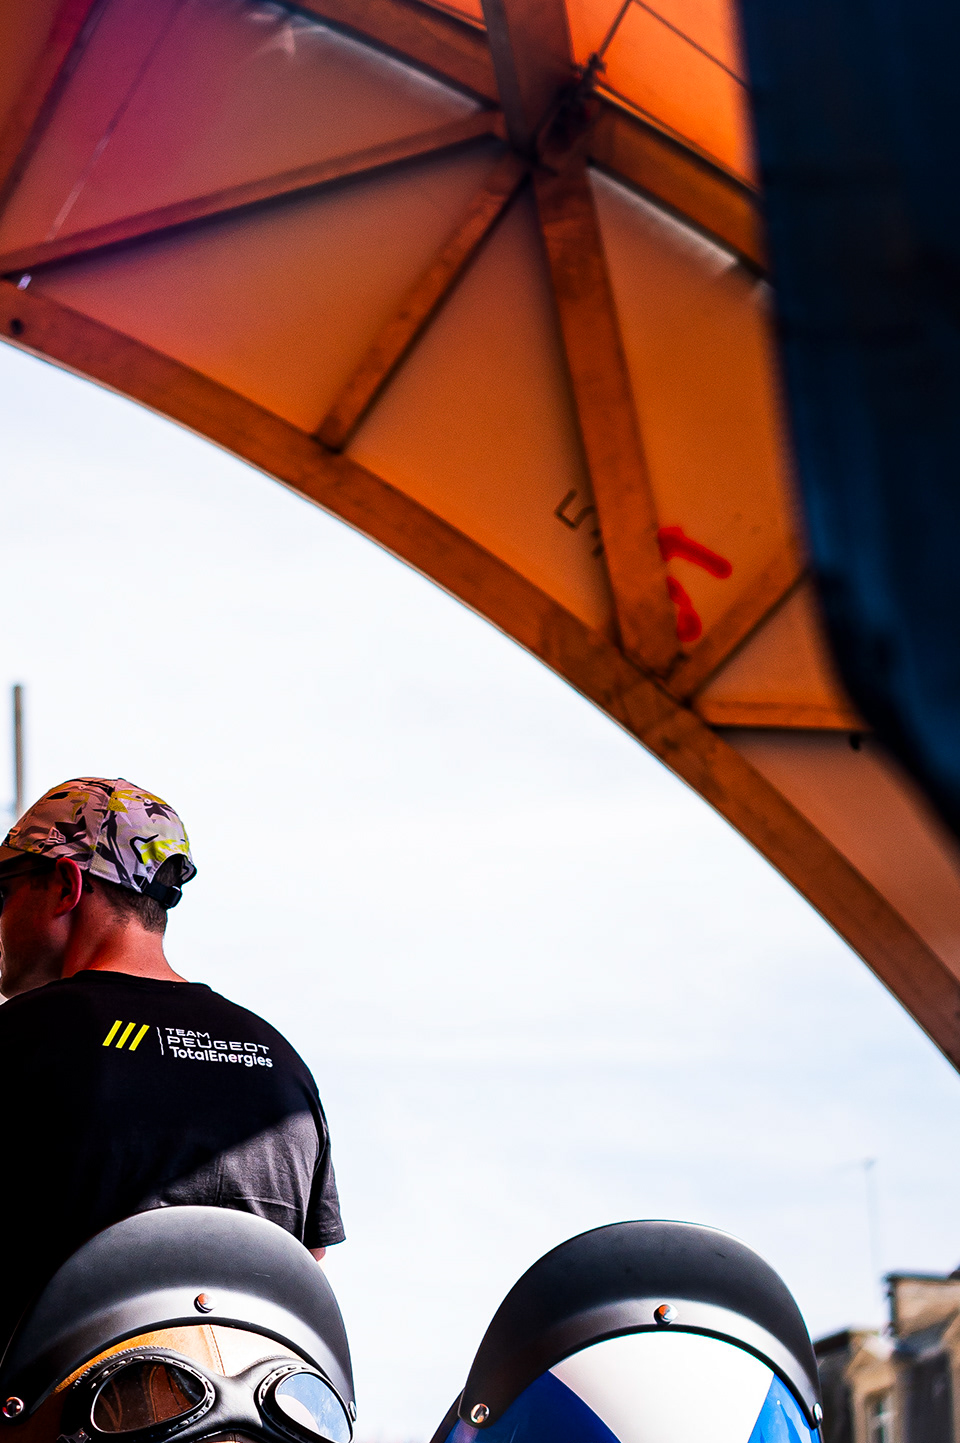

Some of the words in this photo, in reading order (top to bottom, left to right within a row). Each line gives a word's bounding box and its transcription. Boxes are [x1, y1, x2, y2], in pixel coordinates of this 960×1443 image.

[165, 1027, 211, 1039] TEAM
[166, 1035, 270, 1055] PEUGEOT
[169, 1045, 274, 1069] TotalEnergies
